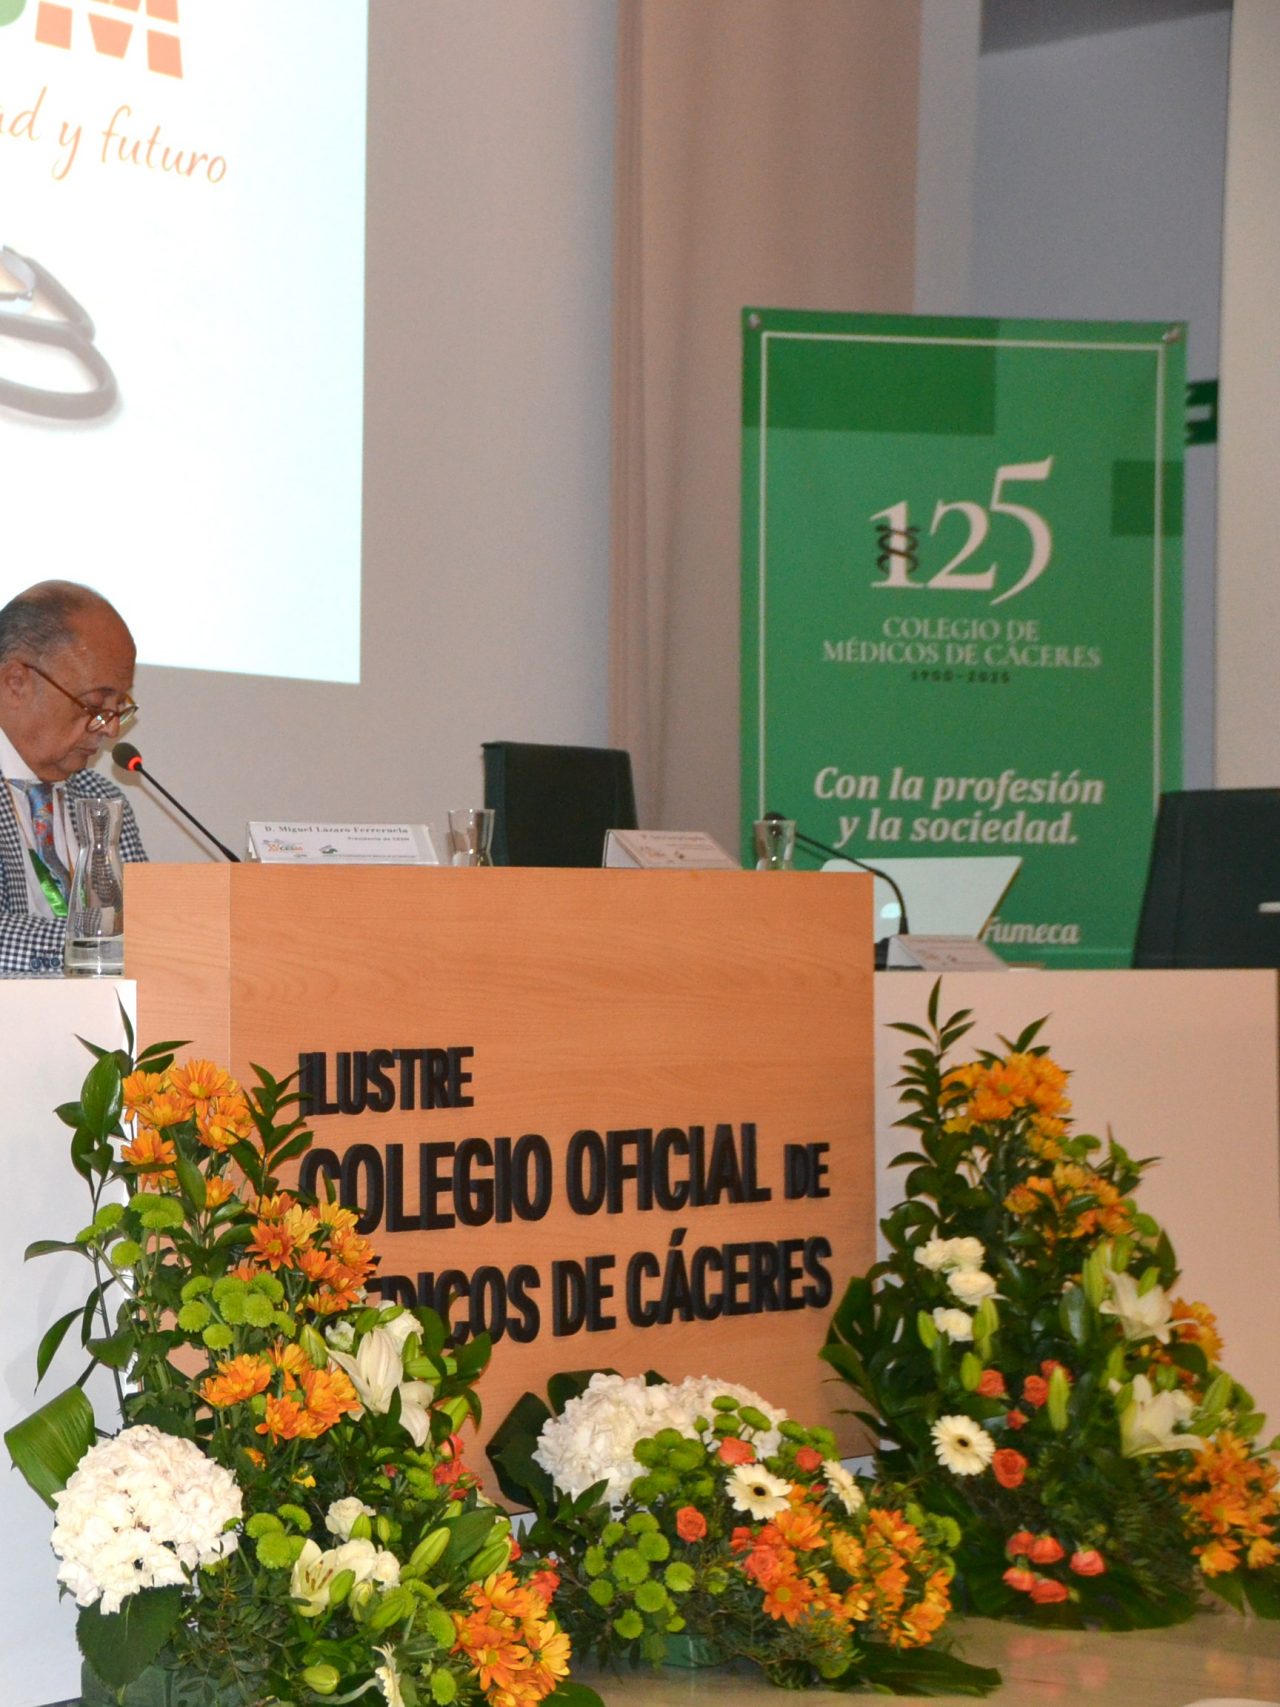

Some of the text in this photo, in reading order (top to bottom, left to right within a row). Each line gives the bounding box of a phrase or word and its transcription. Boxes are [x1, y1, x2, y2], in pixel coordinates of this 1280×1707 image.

[52, 121, 82, 181] y
[101, 105, 227, 183] futuro
[869, 454, 1054, 606] 125
[822, 636, 1103, 668] MÉDICOS DE CÁCERES
[882, 616, 1040, 642] COLEGIO DE
[814, 766, 1105, 811] Con la profesión
[833, 808, 1079, 849] y la sociedad.
[298, 1046, 475, 1117] ILUSTRE
[298, 1122, 831, 1235] COLEGIO OFICIAL DE
[551, 1254, 617, 1337] DE
[625, 1227, 833, 1328] CÁCERES
